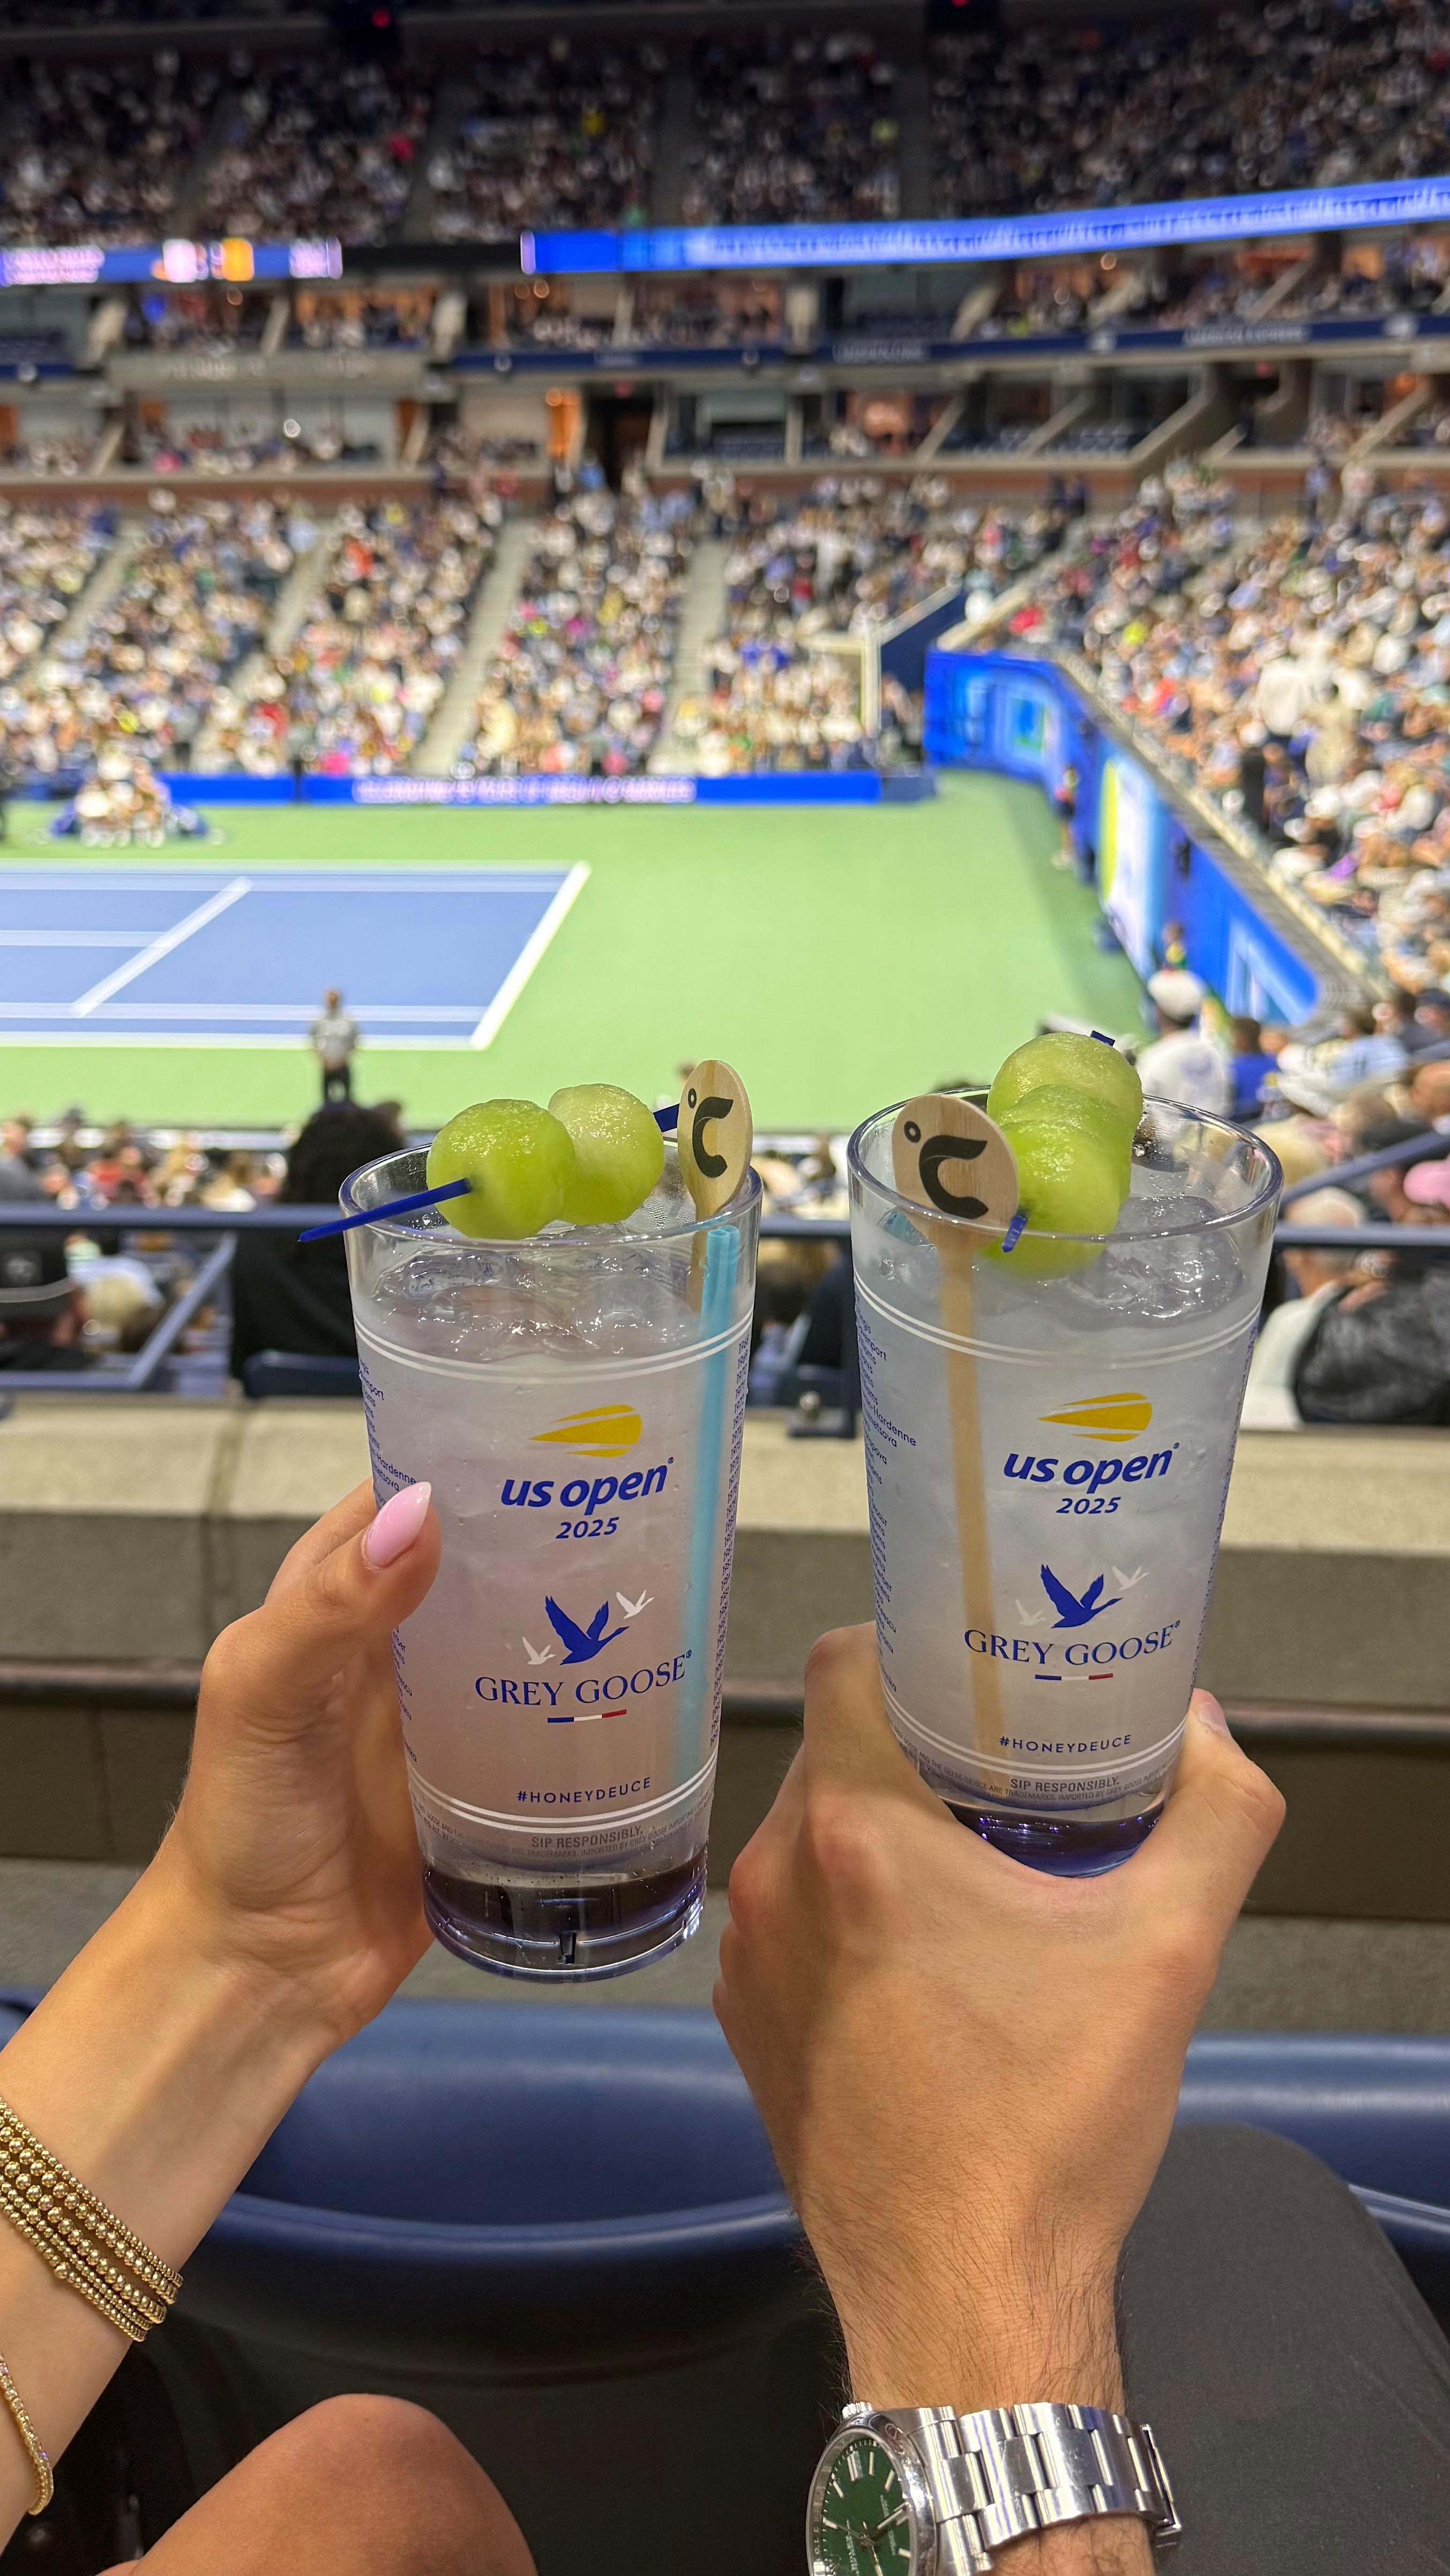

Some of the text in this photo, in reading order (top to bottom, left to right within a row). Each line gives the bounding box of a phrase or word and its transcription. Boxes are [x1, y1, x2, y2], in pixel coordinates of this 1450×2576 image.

[1004, 1453, 1058, 1482] us
[501, 1479, 554, 1507] us
[1056, 1497, 1120, 1514] 2025
[556, 1517, 619, 1539] 2025
[965, 1629, 1054, 1664] GREY
[475, 1677, 564, 1706] GREY
[999, 1734, 1131, 1753] #HONEYDEUCE
[517, 1777, 651, 1803] #HONEYDEUCE
[1011, 1776, 1119, 1792] SIP RESPONSIBLY.
[531, 1836, 552, 1849] SIP
[557, 1825, 644, 1849] RESPONSIBLY.
